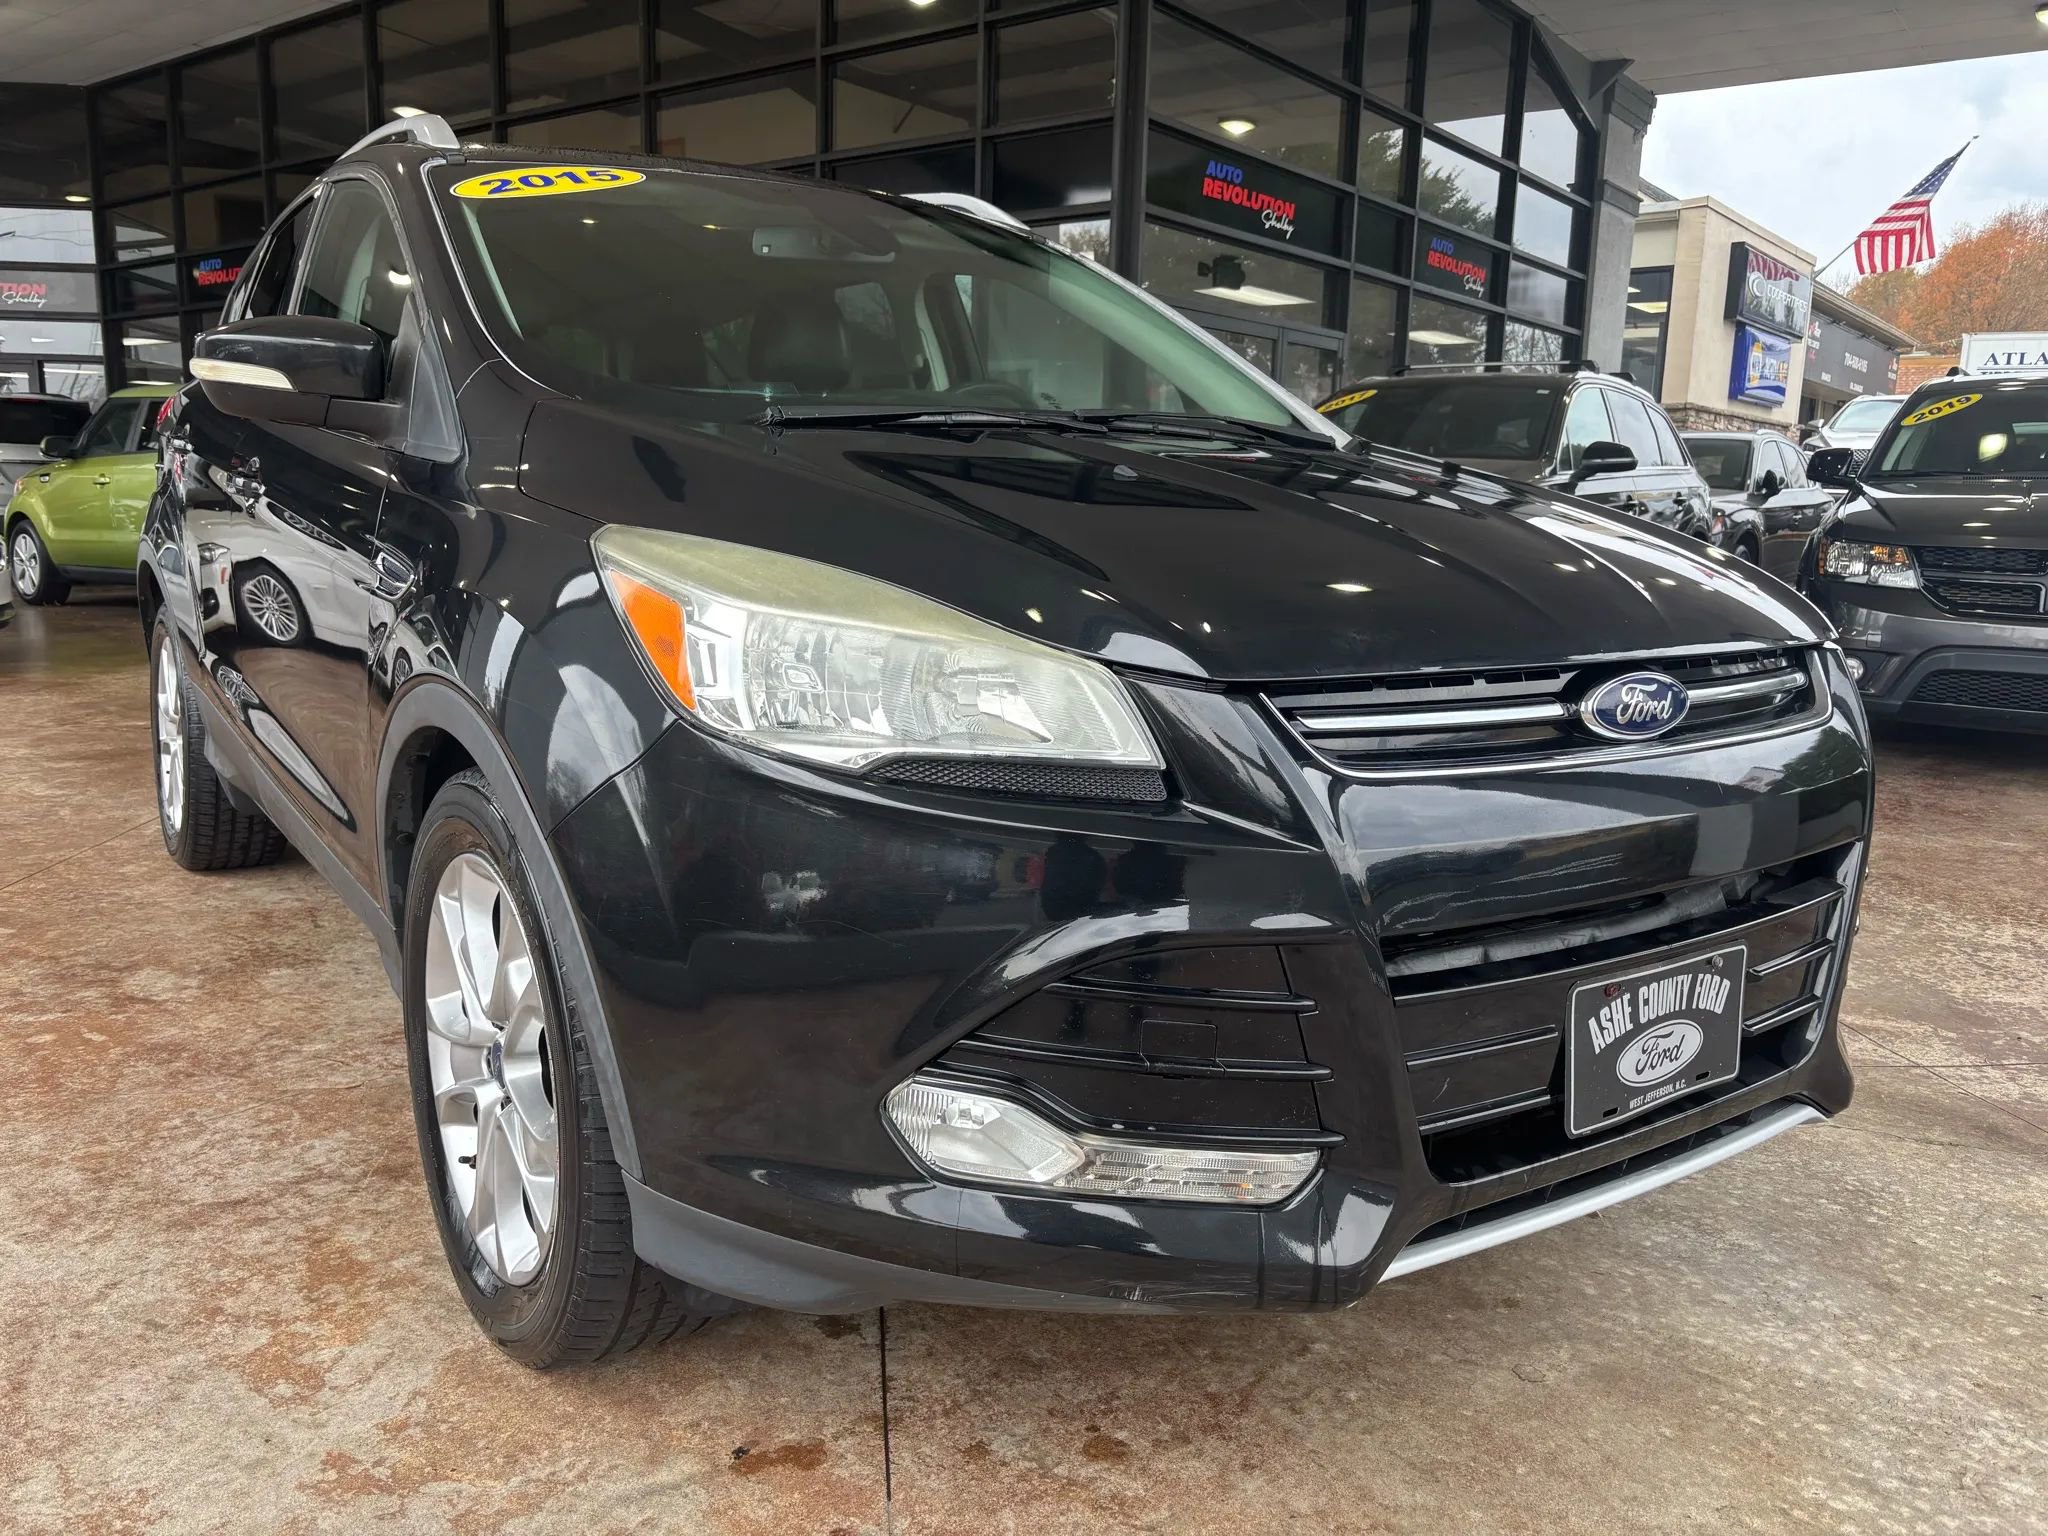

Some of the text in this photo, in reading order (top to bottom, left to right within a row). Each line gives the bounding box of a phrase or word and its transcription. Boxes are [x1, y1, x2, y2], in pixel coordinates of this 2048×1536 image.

[479, 170, 624, 195] 2015
[1206, 160, 1243, 184] AUTO
[1202, 177, 1296, 220] REVOLUTION
[1261, 209, 1295, 240] Shelby
[1431, 237, 1454, 255] AUTO
[199, 258, 222, 271] AUTO
[1427, 250, 1486, 283] REVOLUTION
[2, 291, 47, 308] Shelby
[1912, 396, 1972, 422] 2019
[1616, 683, 1673, 725] Ford
[1588, 973, 1731, 1055] ASHE COUNTY FORD
[1635, 1030, 1686, 1076] Ford
[1629, 1095, 1644, 1110] WEST
